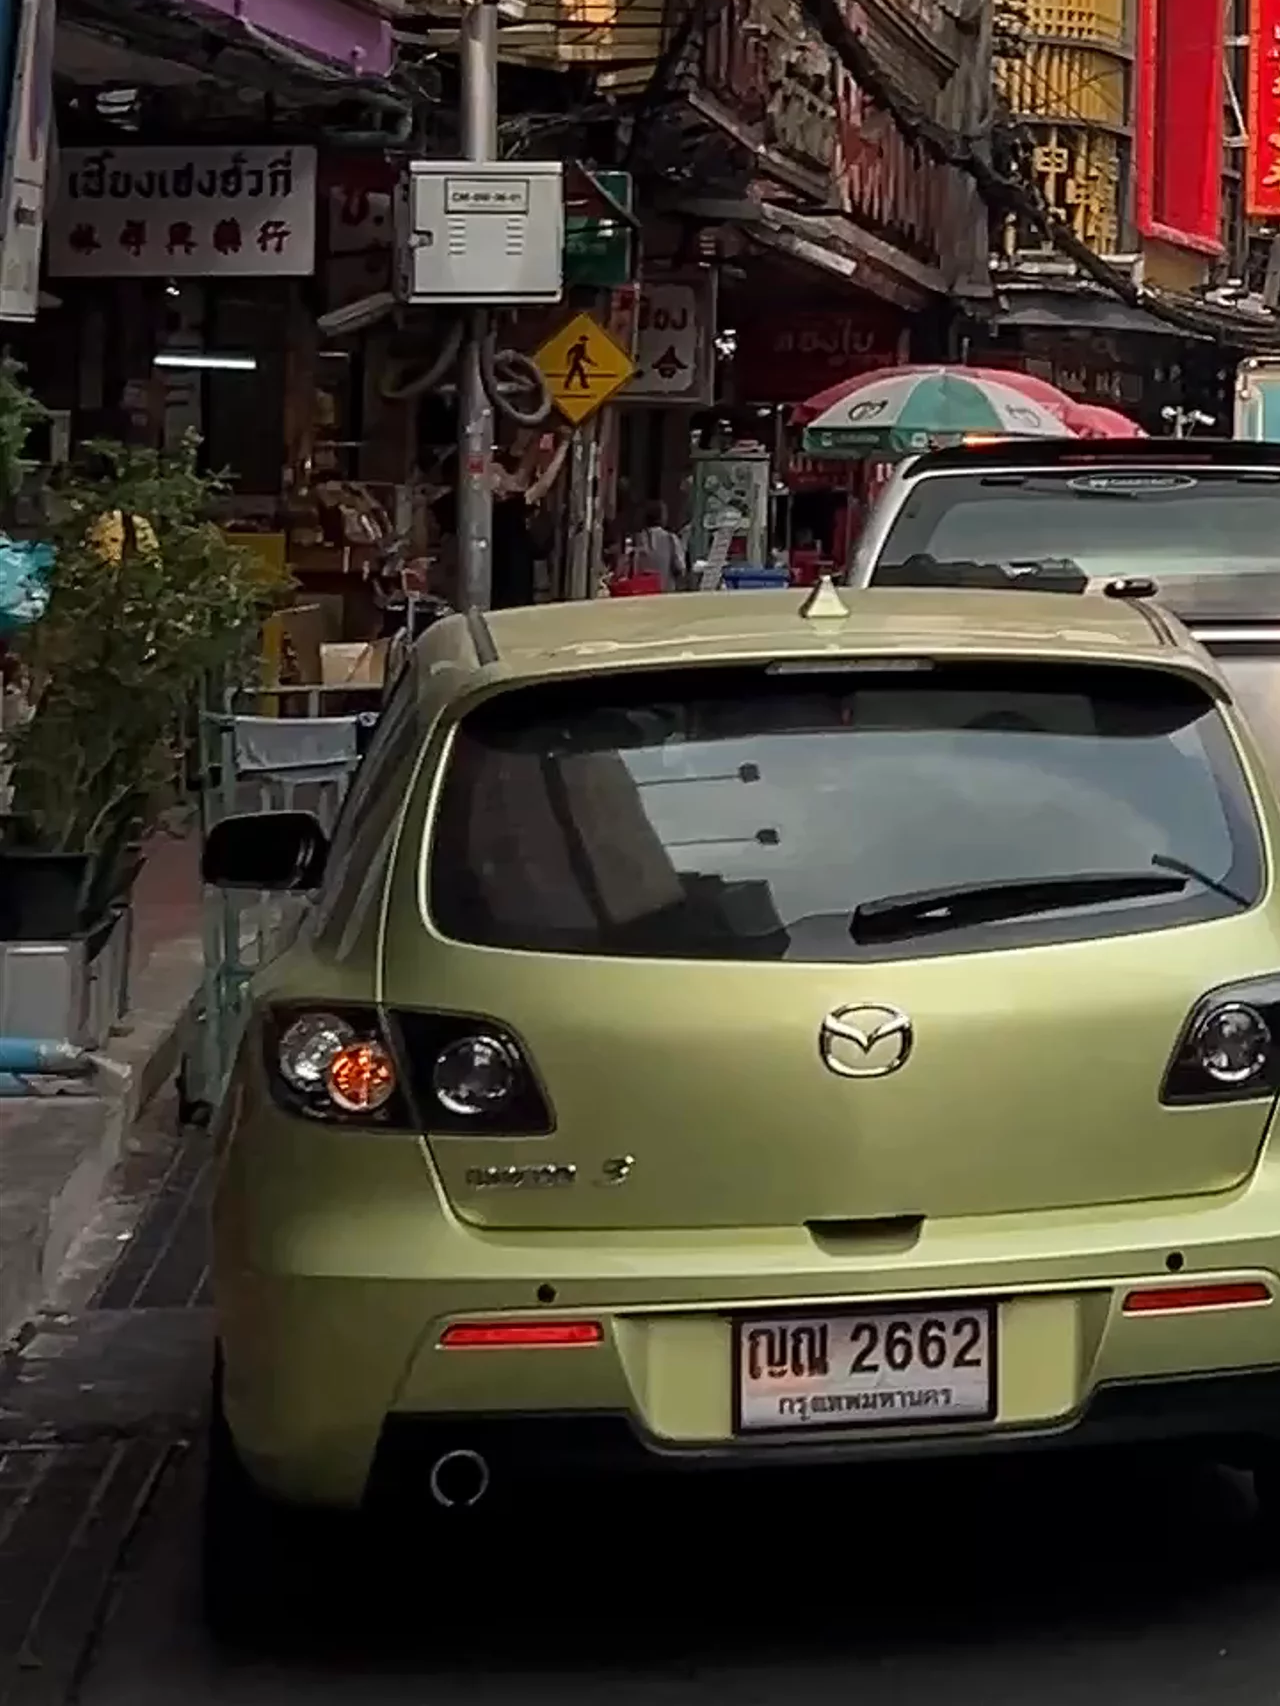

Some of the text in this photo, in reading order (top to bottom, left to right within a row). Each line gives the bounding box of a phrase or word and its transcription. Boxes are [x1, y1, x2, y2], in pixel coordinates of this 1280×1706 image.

[849, 1317, 982, 1375] 2662
[778, 1387, 953, 1422] กรุงเทพมหานคร
